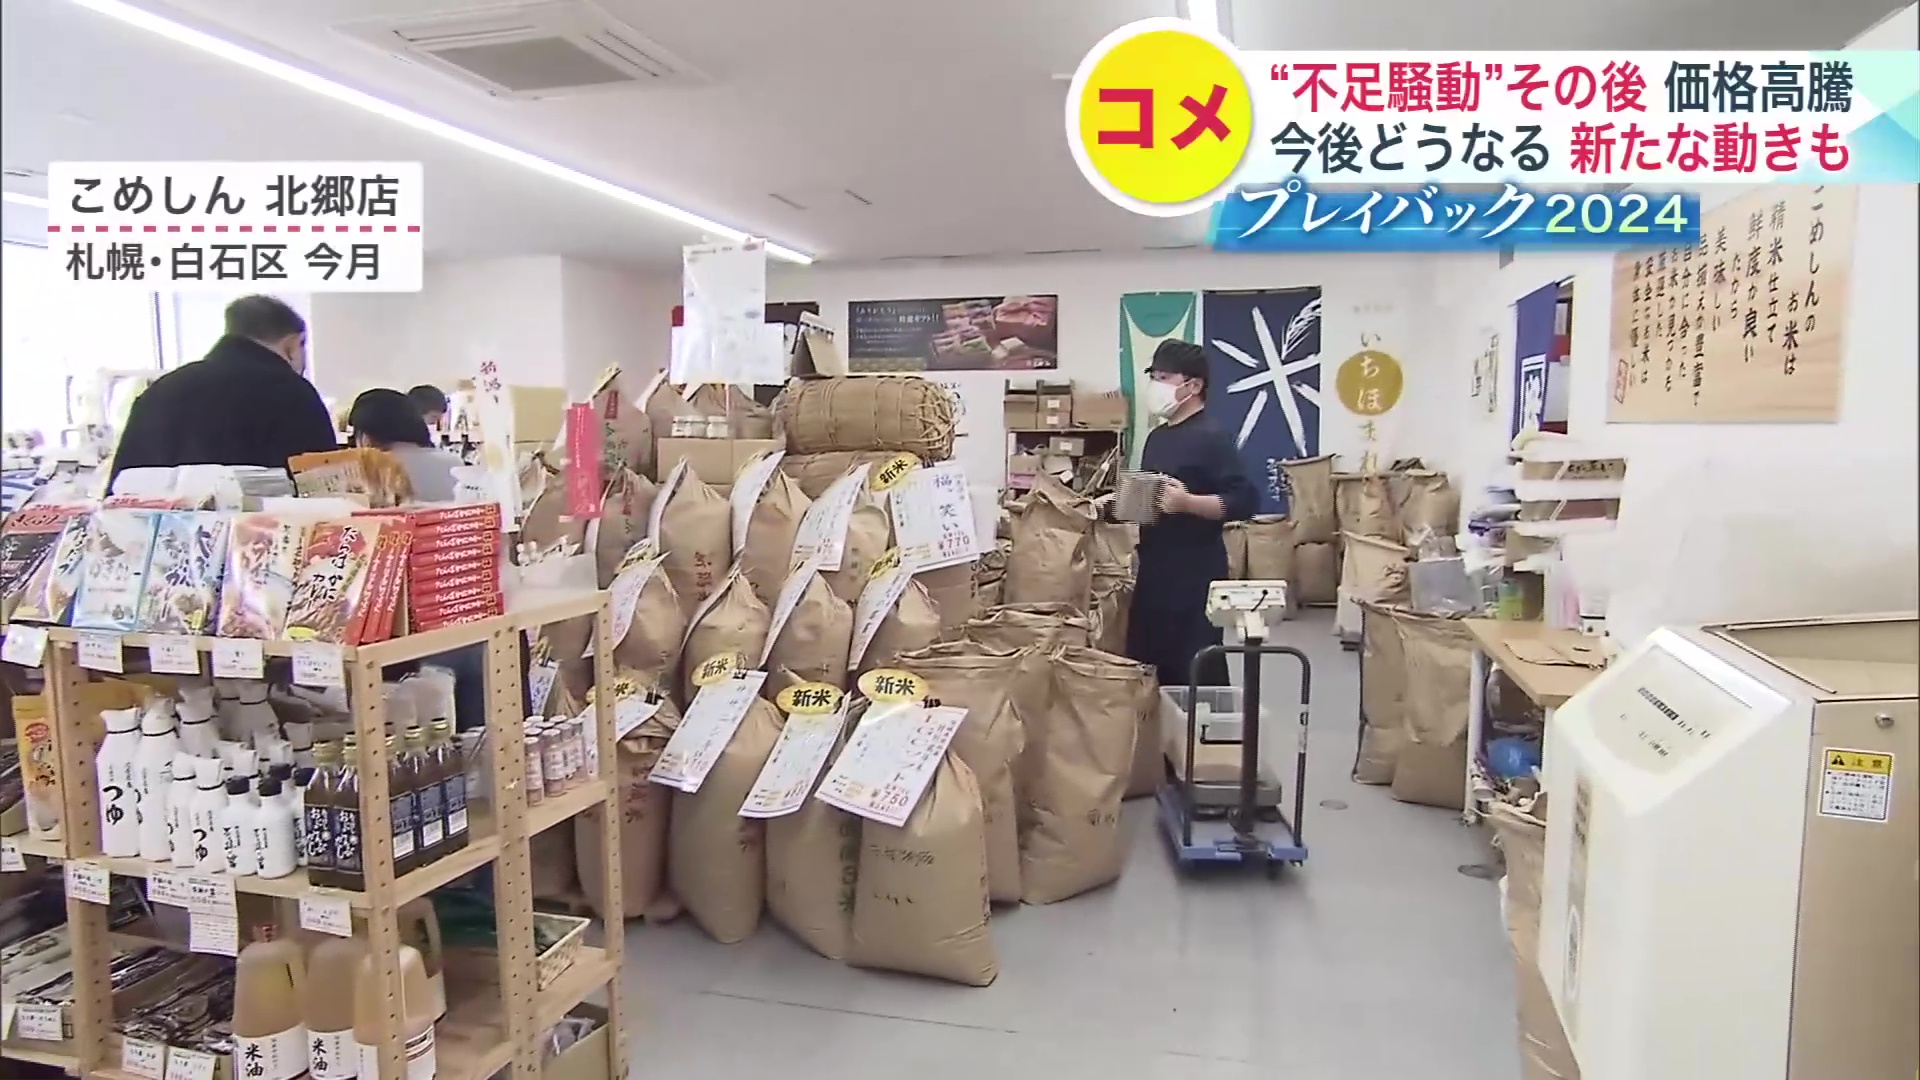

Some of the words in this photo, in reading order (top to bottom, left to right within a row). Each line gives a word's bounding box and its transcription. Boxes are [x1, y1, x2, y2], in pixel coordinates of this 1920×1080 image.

[1713, 225, 1727, 332] 美味しい
[1767, 200, 1786, 344] 精米仕立て
[1782, 290, 1799, 376] お米は
[879, 459, 909, 484] 新米
[701, 657, 730, 680] 新米
[875, 675, 917, 697] 新米
[792, 689, 832, 708] 新米
[102, 785, 126, 826] つゆ
[192, 828, 210, 862] つゆ
[244, 1042, 265, 1078] 米油
[312, 1037, 329, 1072] 米油
